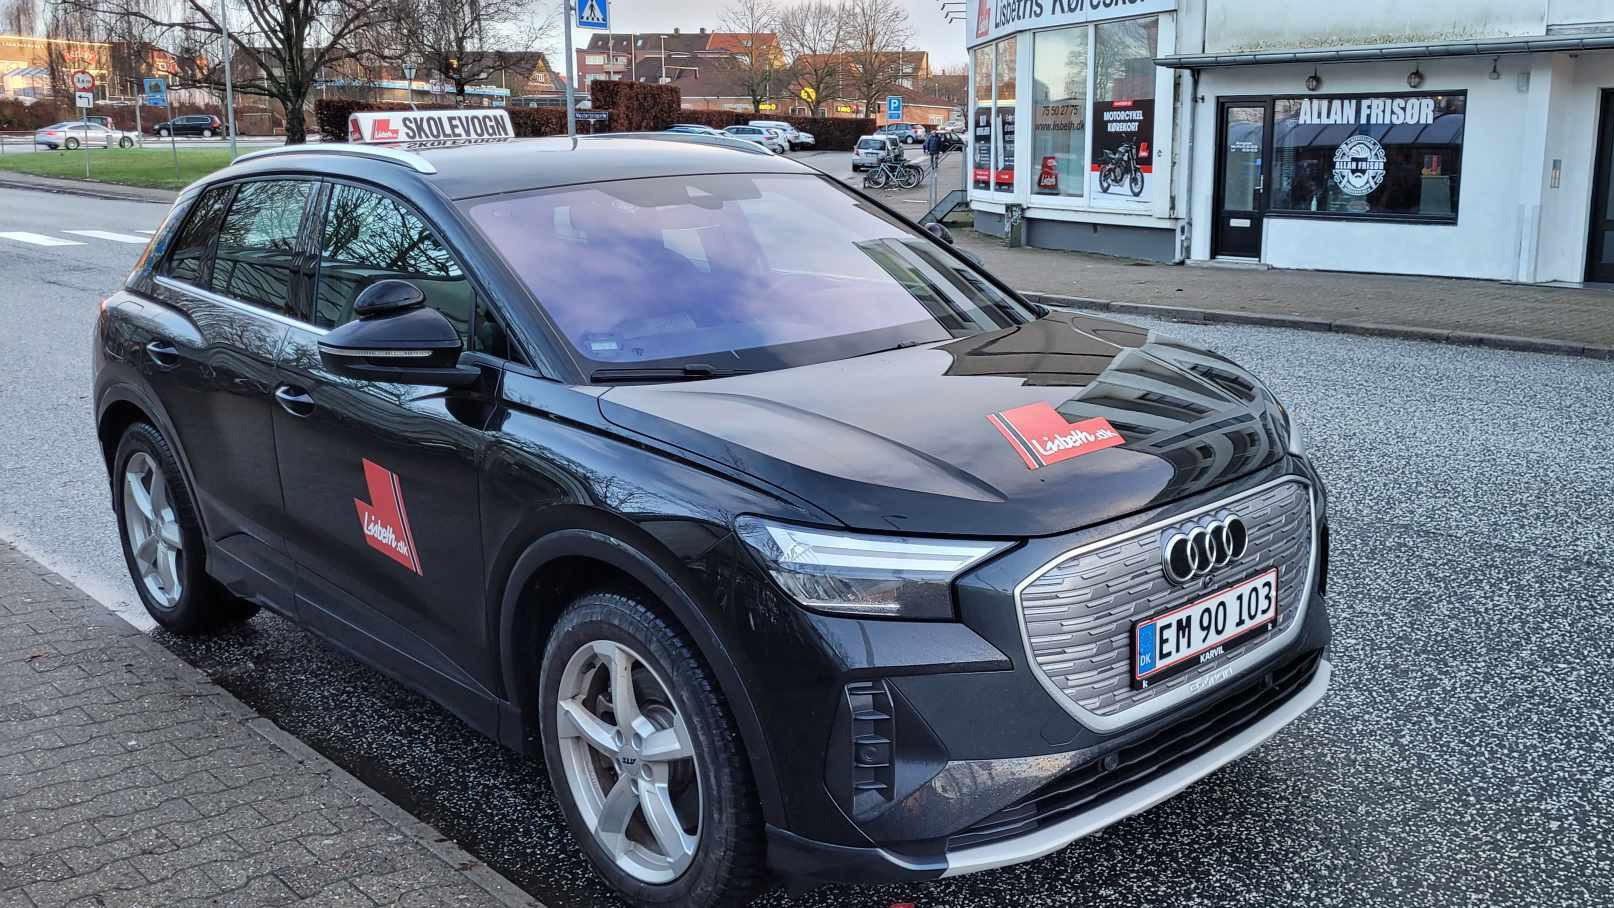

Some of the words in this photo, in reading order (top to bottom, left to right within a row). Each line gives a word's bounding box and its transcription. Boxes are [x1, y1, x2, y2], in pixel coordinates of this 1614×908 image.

[1041, 105, 1050, 116] 75
[1051, 105, 1060, 115] 50
[1103, 111, 1144, 121] MOTORCYKEL
[1299, 99, 1357, 124] ALLAN
[1359, 98, 1435, 124] FRISØR
[402, 115, 508, 139] SKOLEVOGN
[1335, 162, 1356, 170] ALLAN
[1159, 614, 1192, 661] EM
[1199, 600, 1227, 643] 90
[1235, 581, 1272, 627] 103
[1140, 655, 1151, 666] DK
[1199, 645, 1225, 664] KARVIL
